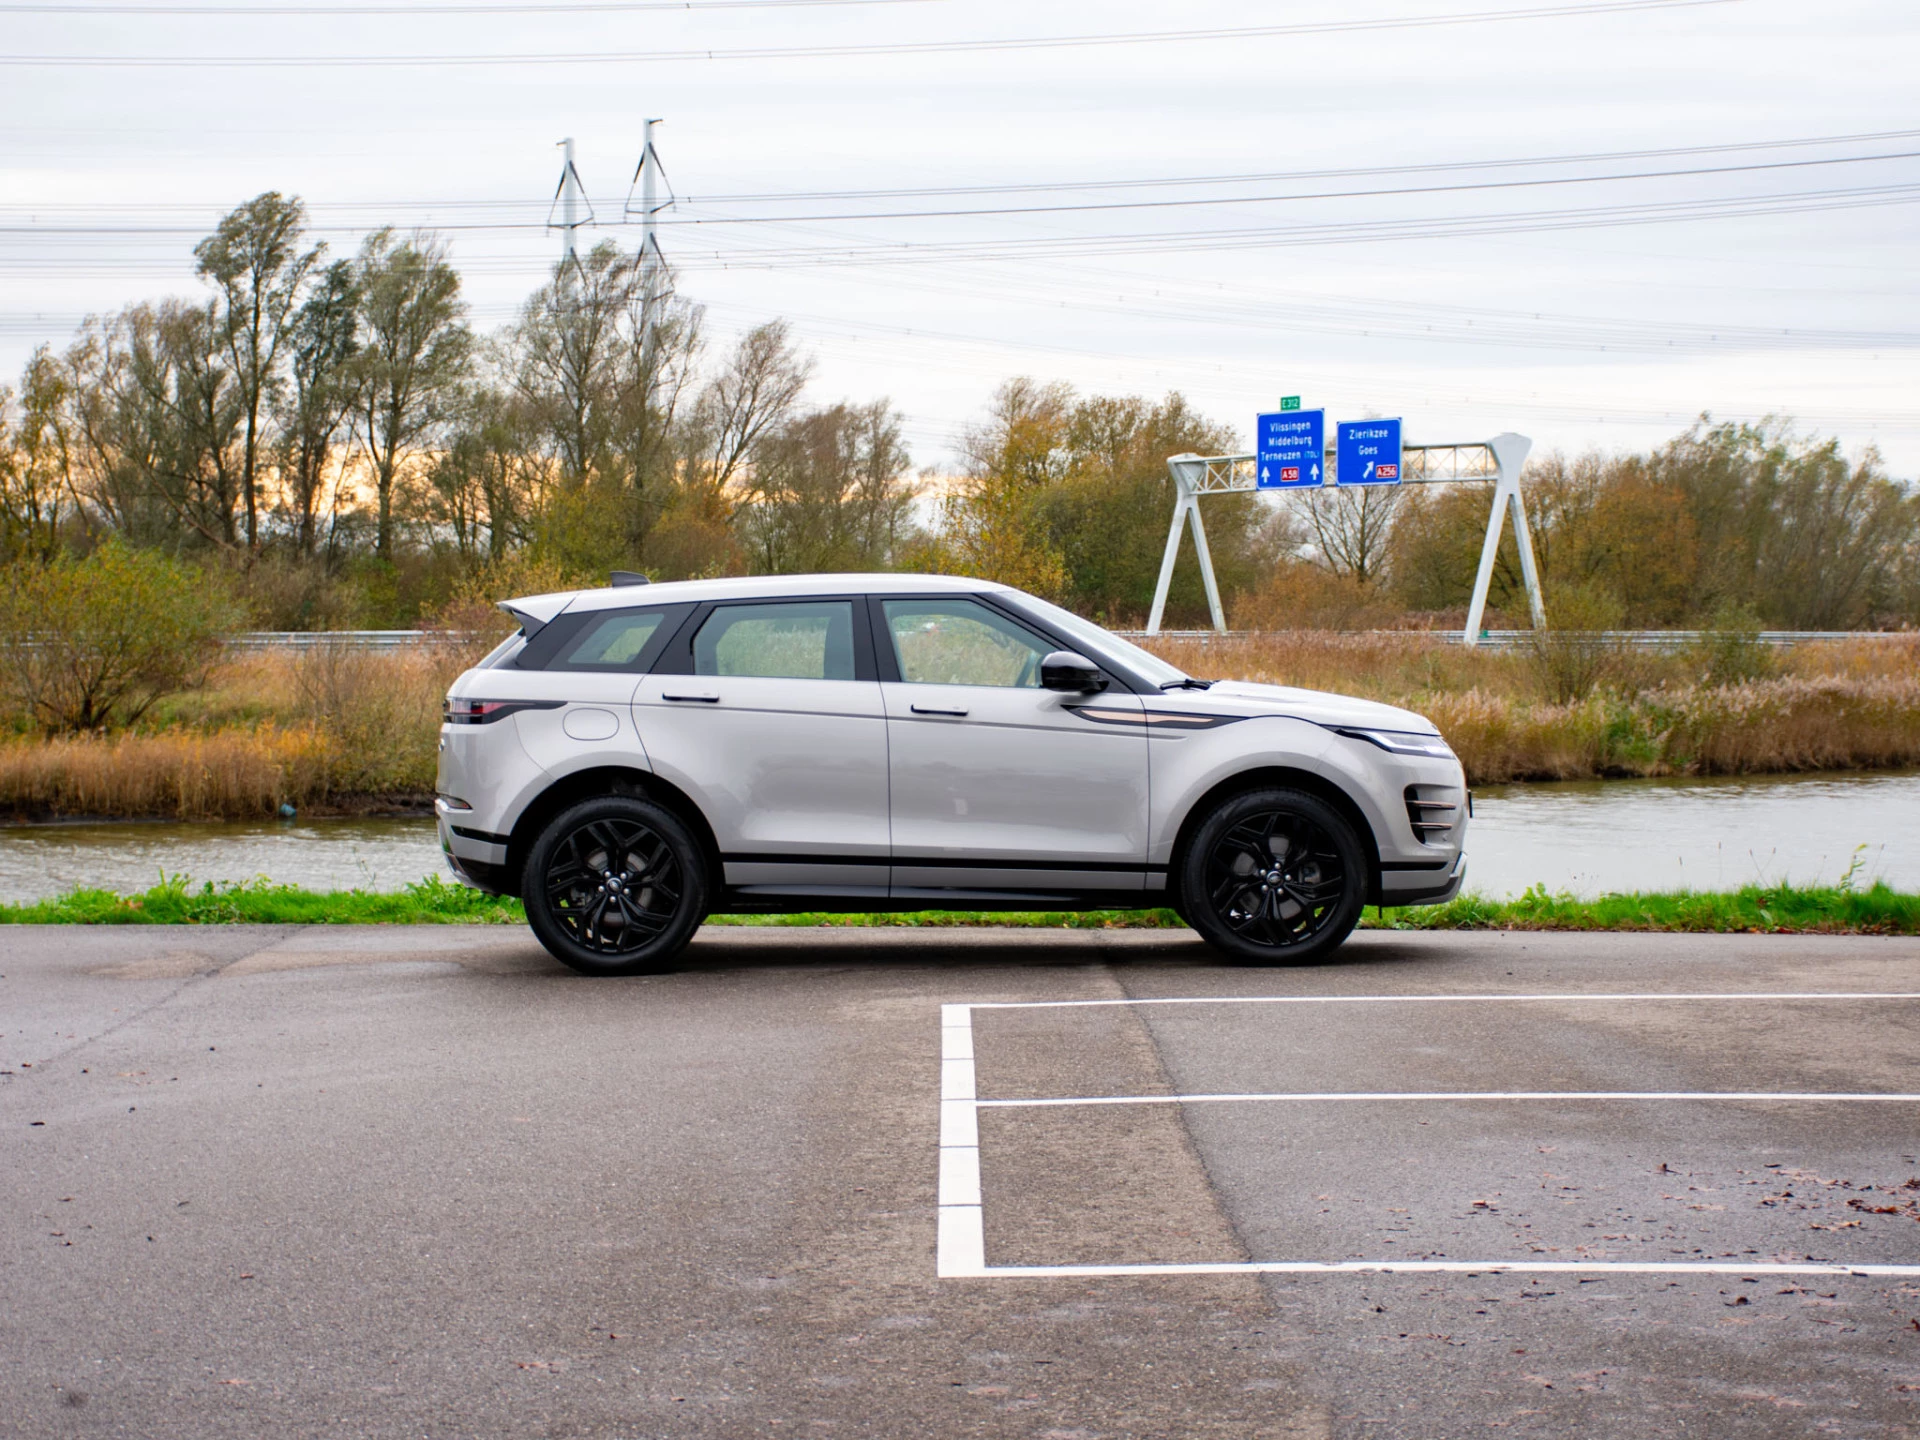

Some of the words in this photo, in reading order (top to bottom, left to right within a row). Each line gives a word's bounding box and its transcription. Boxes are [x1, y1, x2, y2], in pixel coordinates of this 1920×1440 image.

[1270, 421, 1311, 433] Vlissingen
[1349, 429, 1389, 440] Zierikzee
[1268, 435, 1312, 447] Middelburg
[1261, 451, 1301, 461] Terneuzen
[1358, 445, 1378, 456] Goes
